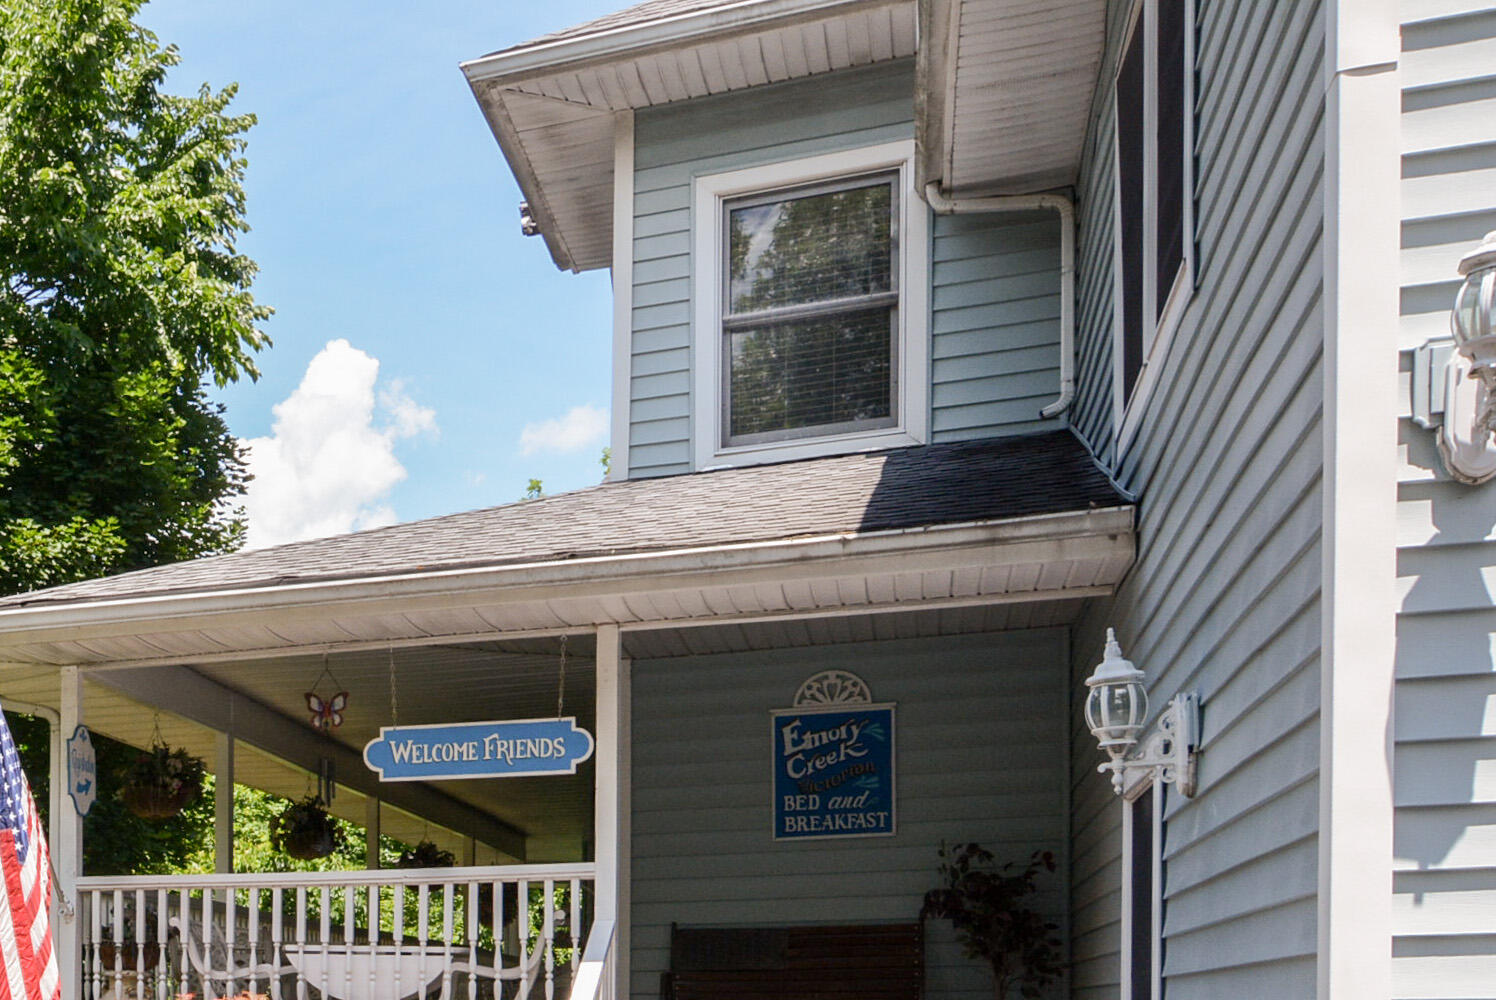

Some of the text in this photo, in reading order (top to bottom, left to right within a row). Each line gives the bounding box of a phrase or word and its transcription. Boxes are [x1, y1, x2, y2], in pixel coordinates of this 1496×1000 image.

[389, 733, 566, 766] WELCOME FRIENDS
[782, 718, 869, 756] Emory
[786, 742, 869, 779] Creek
[783, 790, 870, 811] BED and
[784, 811, 889, 833] BREAKFAST
